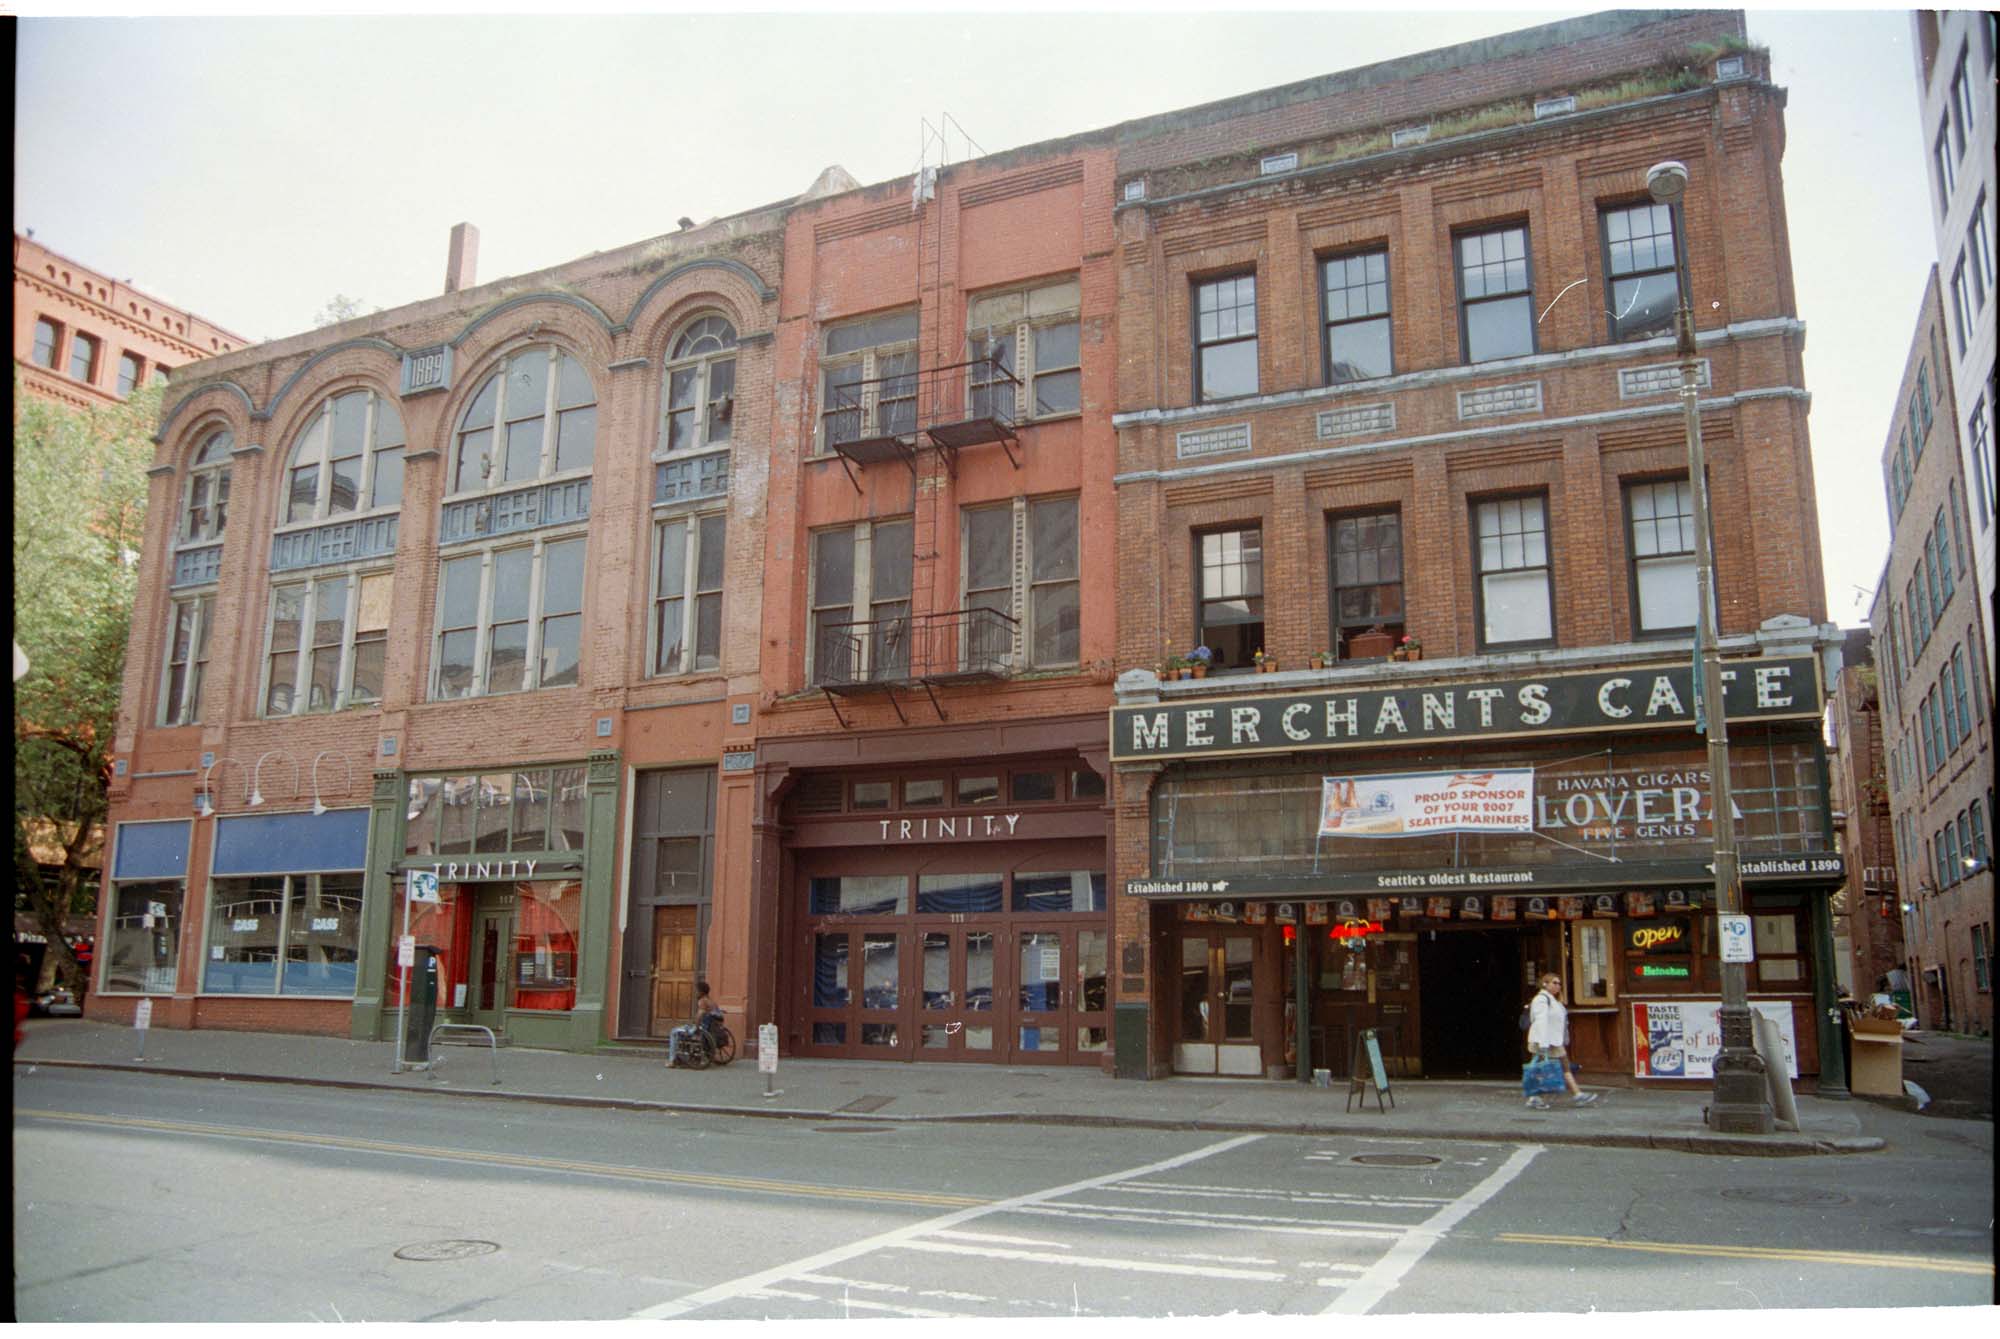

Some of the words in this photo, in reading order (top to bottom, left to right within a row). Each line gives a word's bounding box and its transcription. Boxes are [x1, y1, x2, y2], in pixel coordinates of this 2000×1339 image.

[411, 353, 444, 388] 1889
[1132, 683, 1553, 750] MERCHANTS
[1557, 775, 1629, 792] HAVANA
[1414, 791, 1458, 804] PROUD
[1461, 789, 1526, 801] SPONSOR
[1423, 804, 1441, 815] OF
[1443, 802, 1479, 813] YOUR
[1483, 801, 1515, 813] 2007
[879, 813, 1021, 840] TRINITY
[1408, 815, 1458, 828] SEATTLE
[1461, 812, 1530, 825] MARINERS
[1583, 827, 1626, 841] FIVE
[432, 858, 538, 881] TRINITY
[1738, 860, 1807, 874] stablished
[1810, 859, 1841, 871] 1890
[1377, 874, 1426, 887] Seattle's
[1429, 873, 1465, 885] Oldest
[1469, 871, 1534, 884] Restaurant
[1127, 881, 1184, 894] Established
[1186, 881, 1209, 892] 1890
[1632, 925, 1682, 949] Open
[1648, 1013, 1681, 1021] MUSIC
[1649, 1020, 1683, 1032] LIVE
[1686, 1029, 1702, 1048] of
[1706, 1032, 1721, 1046] th
[1687, 1055, 1713, 1063] Ever
